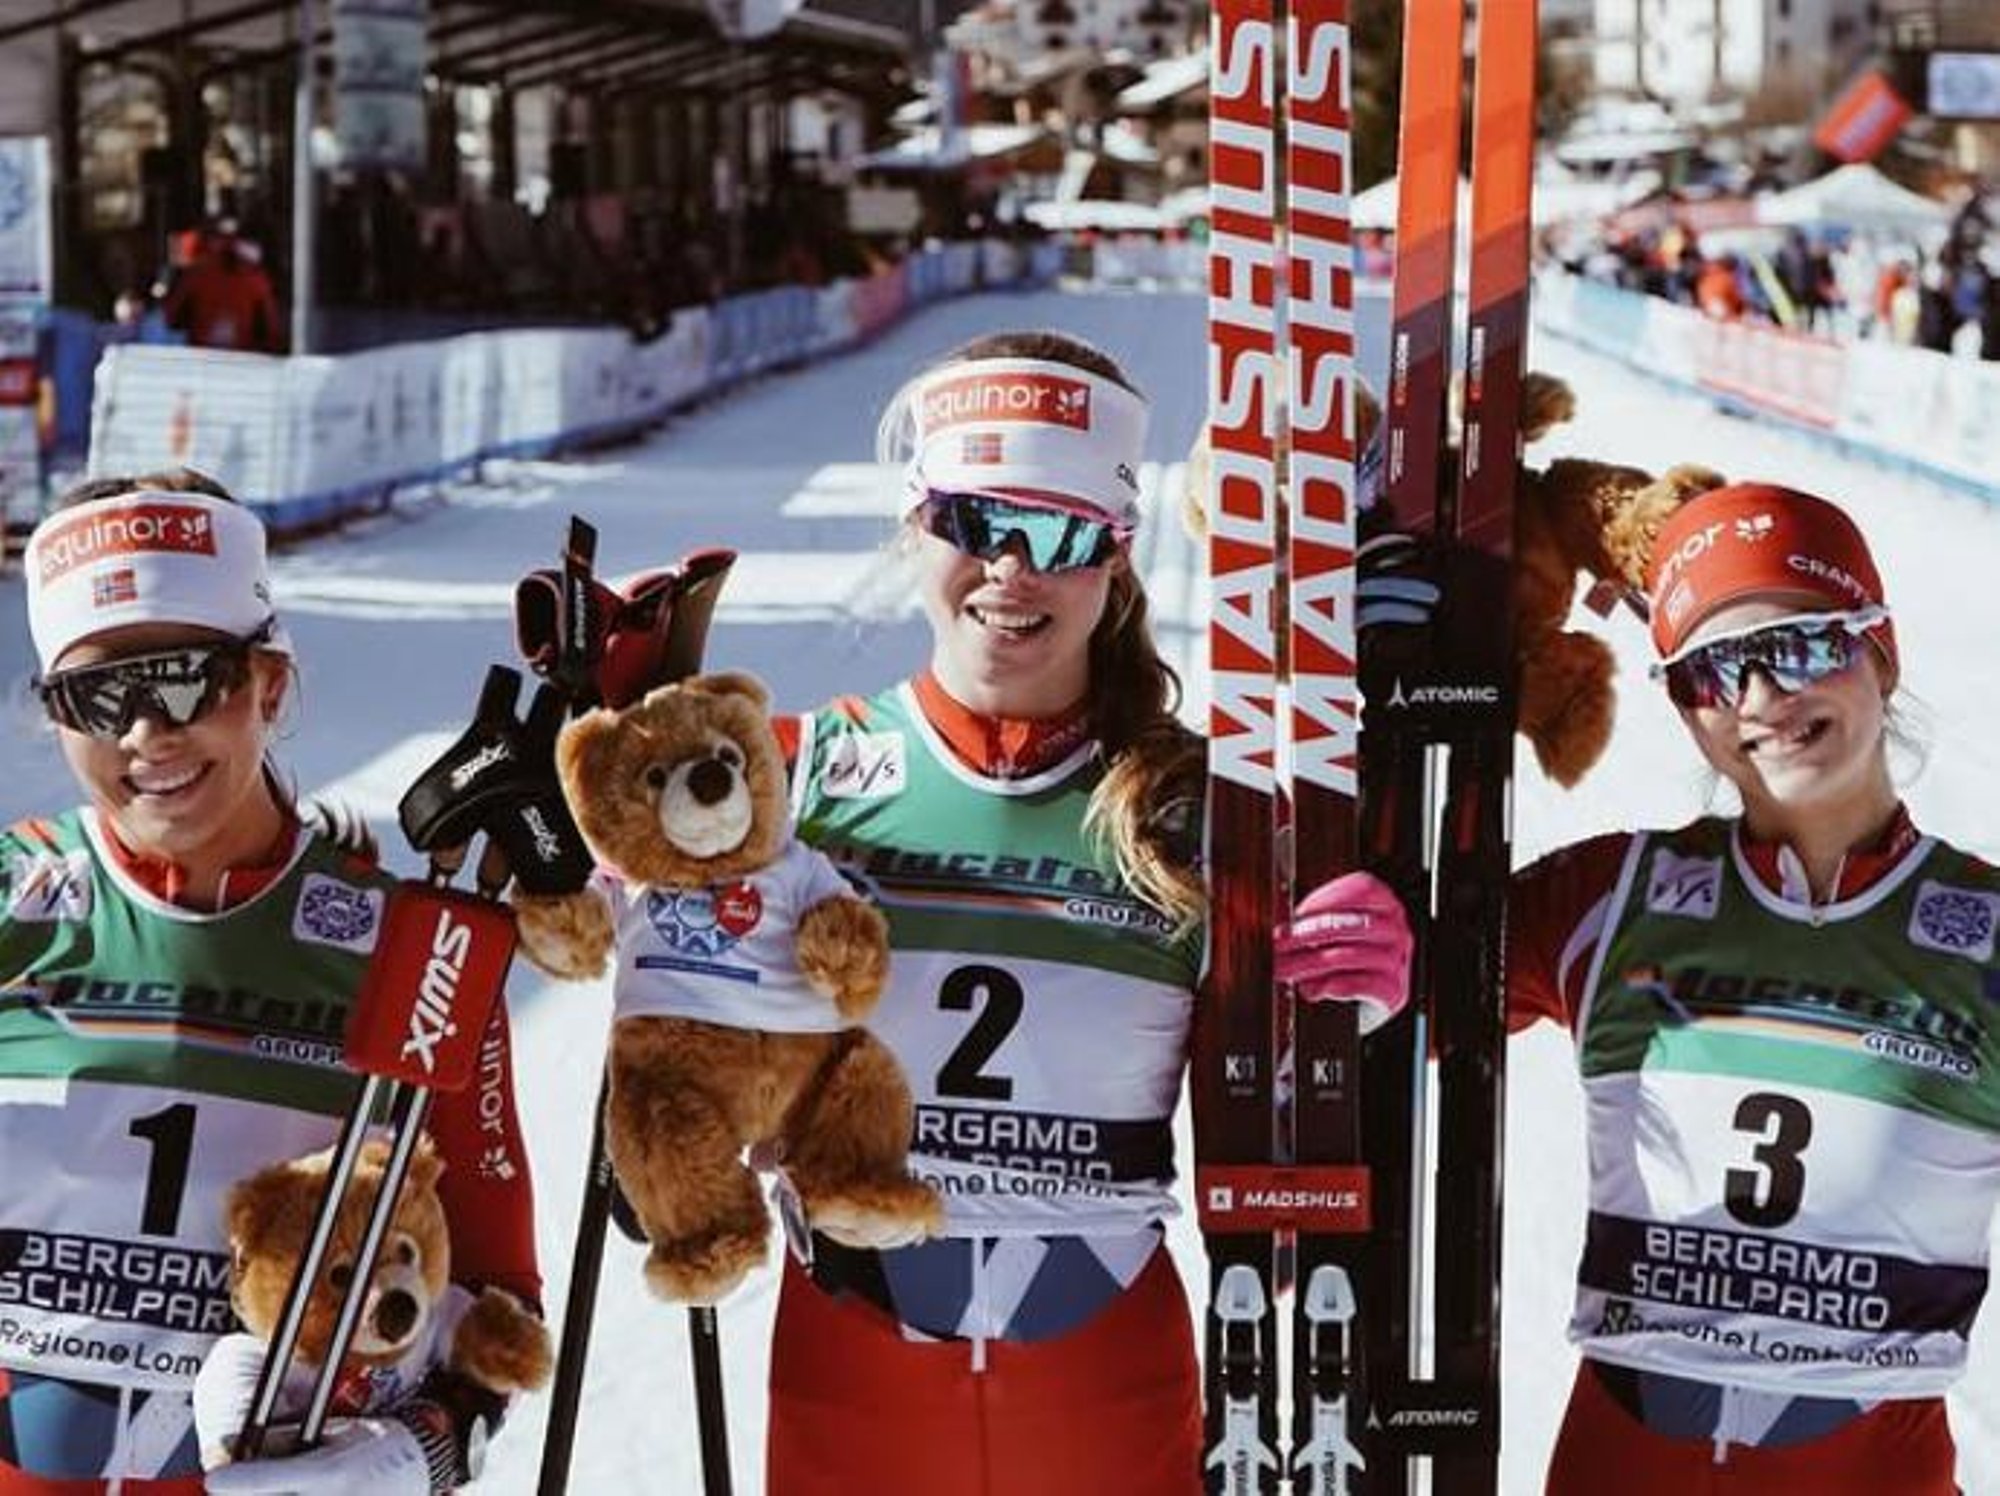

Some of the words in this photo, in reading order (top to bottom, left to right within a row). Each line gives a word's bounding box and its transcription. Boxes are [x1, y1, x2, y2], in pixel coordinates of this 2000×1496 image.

[1209, 14, 1275, 795] MADSHUS
[1286, 16, 1358, 797] MADSHUS
[1408, 686, 1499, 703] ATOMIC
[1066, 900, 1176, 934] GRUPPO
[254, 1035, 345, 1066] GRUPP
[936, 965, 1024, 1101] 2
[1864, 1030, 1977, 1076] GRUPPO
[918, 1110, 1098, 1154] RGAMO
[1723, 1091, 1812, 1229] 3
[128, 1103, 196, 1237] 1
[1242, 1190, 1359, 1208] MADSHUS
[18, 1235, 231, 1291] BERGAM
[1645, 1226, 1879, 1290] BERGAMO
[0, 1270, 238, 1328] SCHILPAR
[1632, 1263, 1890, 1329] SCHILPARIO
